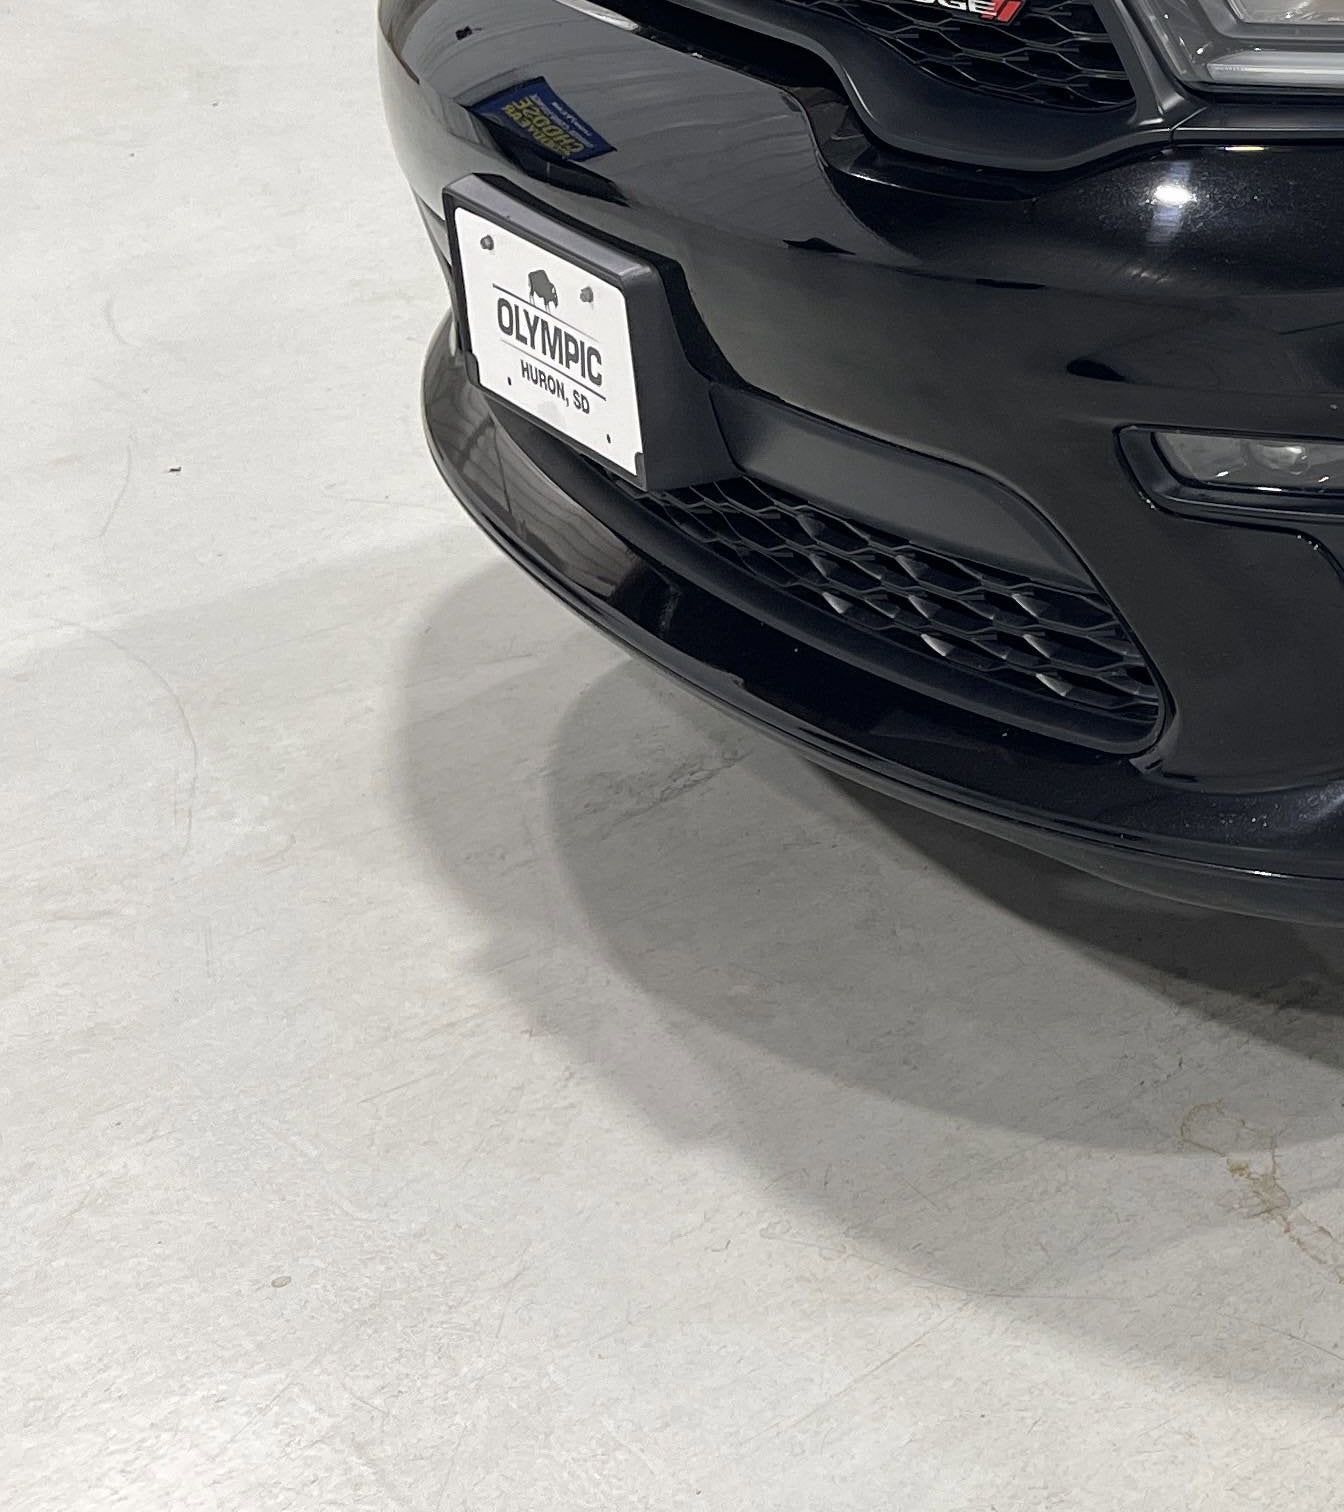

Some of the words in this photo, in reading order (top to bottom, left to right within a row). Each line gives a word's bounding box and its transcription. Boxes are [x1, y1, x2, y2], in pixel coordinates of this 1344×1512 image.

[497, 297, 603, 388] OLYMPIC
[520, 358, 570, 408] HURON,
[572, 388, 590, 415] SD
